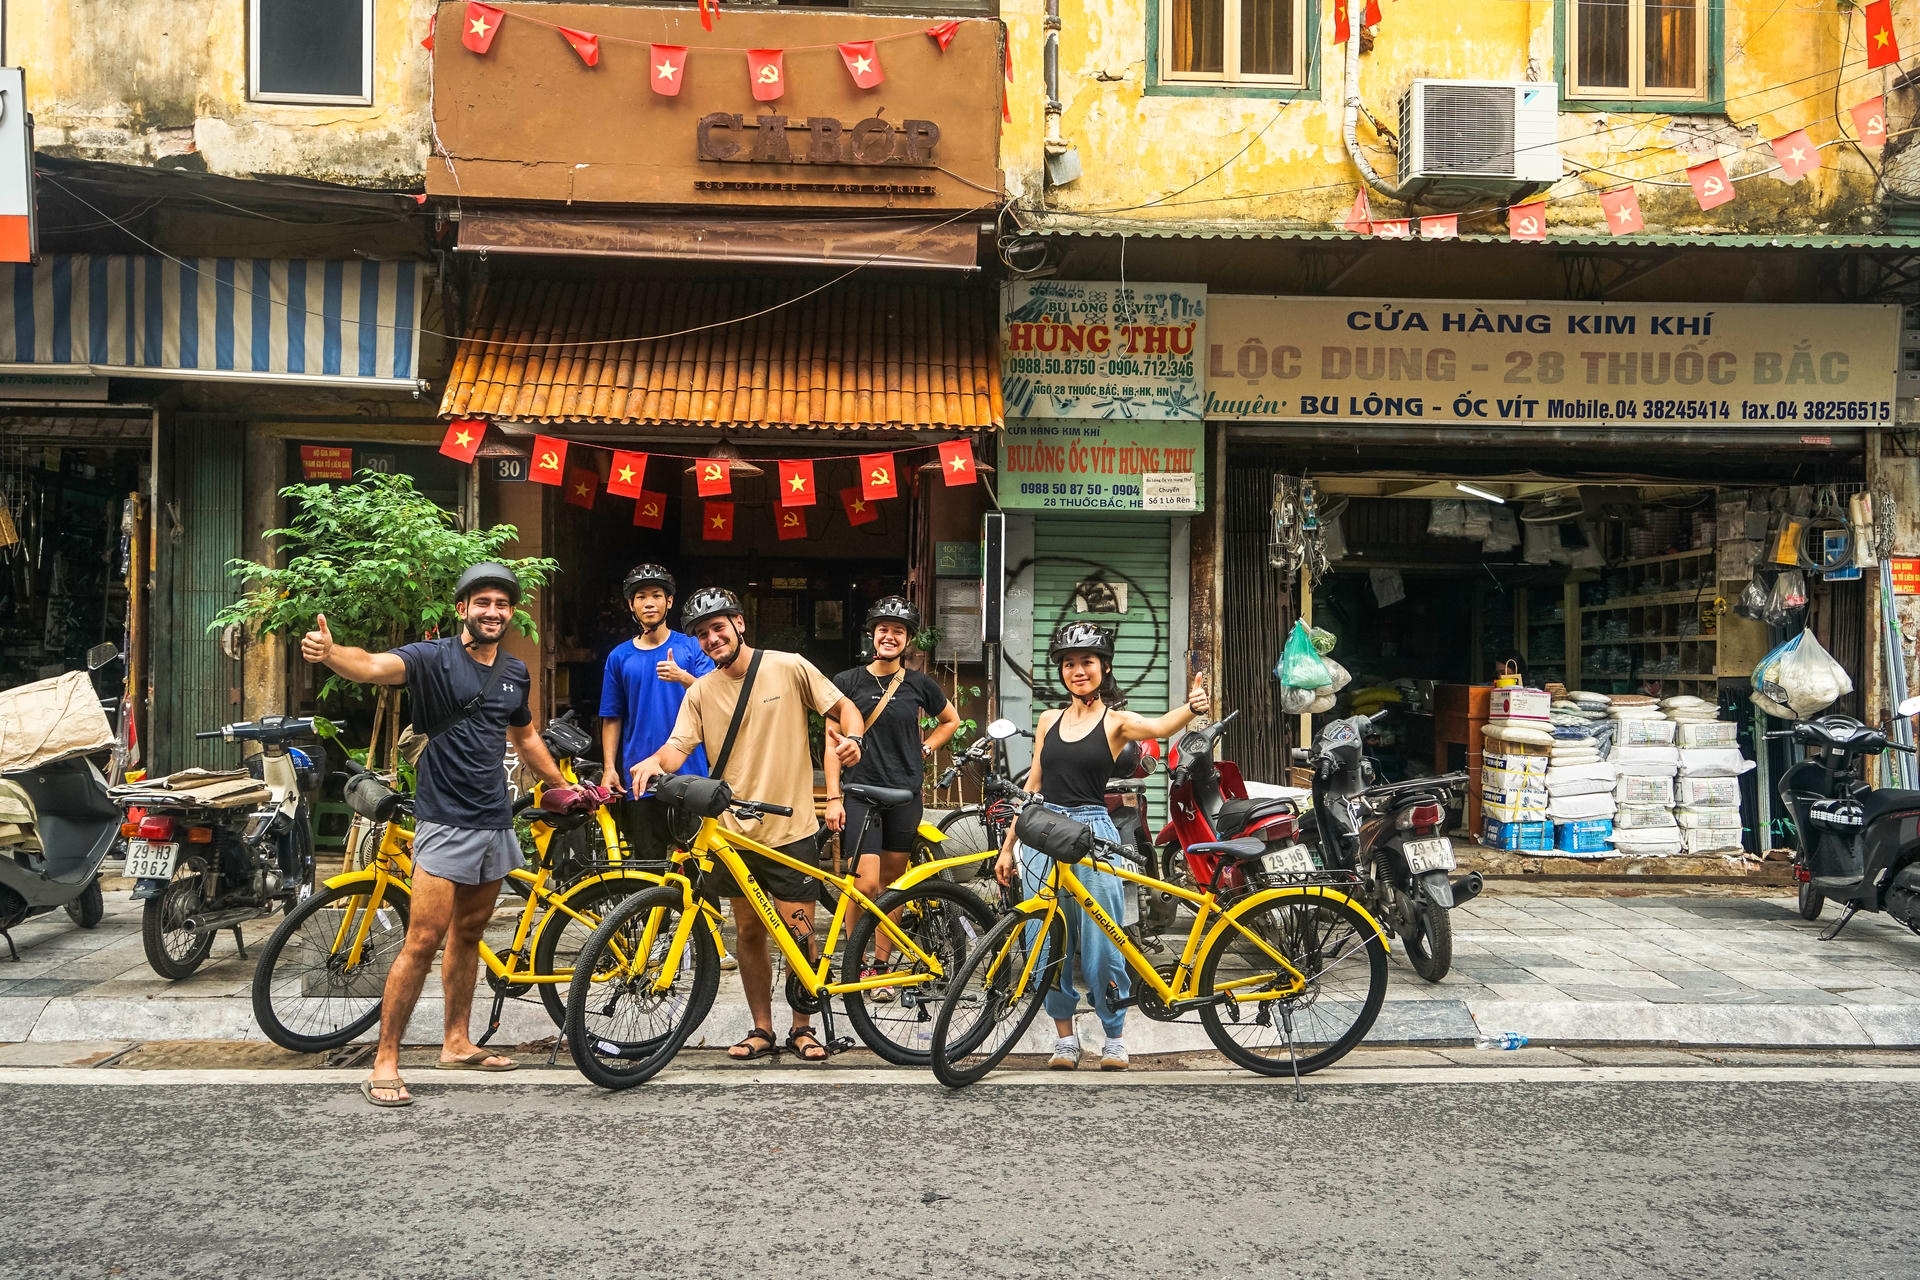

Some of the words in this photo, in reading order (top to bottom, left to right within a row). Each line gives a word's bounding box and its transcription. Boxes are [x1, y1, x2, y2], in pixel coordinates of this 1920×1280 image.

[873, 184, 937, 193] CORNER
[1048, 301, 1067, 312] BU
[1071, 299, 1108, 313] LÔNG
[1346, 303, 1429, 331] CỬA
[1442, 307, 1551, 334] HÀNG
[1567, 315, 1636, 335] KIM
[1650, 311, 1716, 336] KHÍ
[1008, 316, 1111, 353] HÙNG
[1120, 321, 1196, 354] THƯ
[1010, 357, 1096, 375] 0988.50.8750
[1108, 359, 1194, 377] 0904.712.346
[1209, 337, 1303, 386] LỘC
[1321, 346, 1456, 382] DUNG
[1503, 350, 1564, 385] 28
[1580, 338, 1737, 385] THUỐC
[1753, 338, 1850, 385] BẮC
[1055, 385, 1066, 395] 28
[1156, 387, 1169, 396] HN
[1300, 395, 1339, 416] BU
[1350, 391, 1423, 417] LÔNG
[1452, 390, 1488, 418] ỐC
[1496, 393, 1540, 419] VÍT
[1642, 400, 1730, 420] 38245414
[1741, 401, 1798, 420] fax.04
[1803, 401, 1890, 421] 38256515
[1062, 427, 1080, 436] KIM
[1068, 437, 1088, 473] ỐC
[1090, 439, 1116, 474] VÍT
[1119, 440, 1160, 475] HÙNG
[368, 458, 388, 473] 30
[499, 459, 521, 477] 30
[1020, 483, 1049, 494] 0988
[1052, 483, 1067, 494] 50
[1069, 484, 1083, 495] 87
[1087, 484, 1102, 495] 50
[1112, 484, 1140, 496] 0904
[1043, 498, 1057, 506] 28
[1148, 496, 1158, 504] Số
[134, 844, 171, 859] 29-H3
[1268, 848, 1304, 870] 29-H6
[131, 860, 169, 875] 3962
[752, 887, 780, 930] Jackfruit
[1091, 909, 1127, 947] Jackfruit
